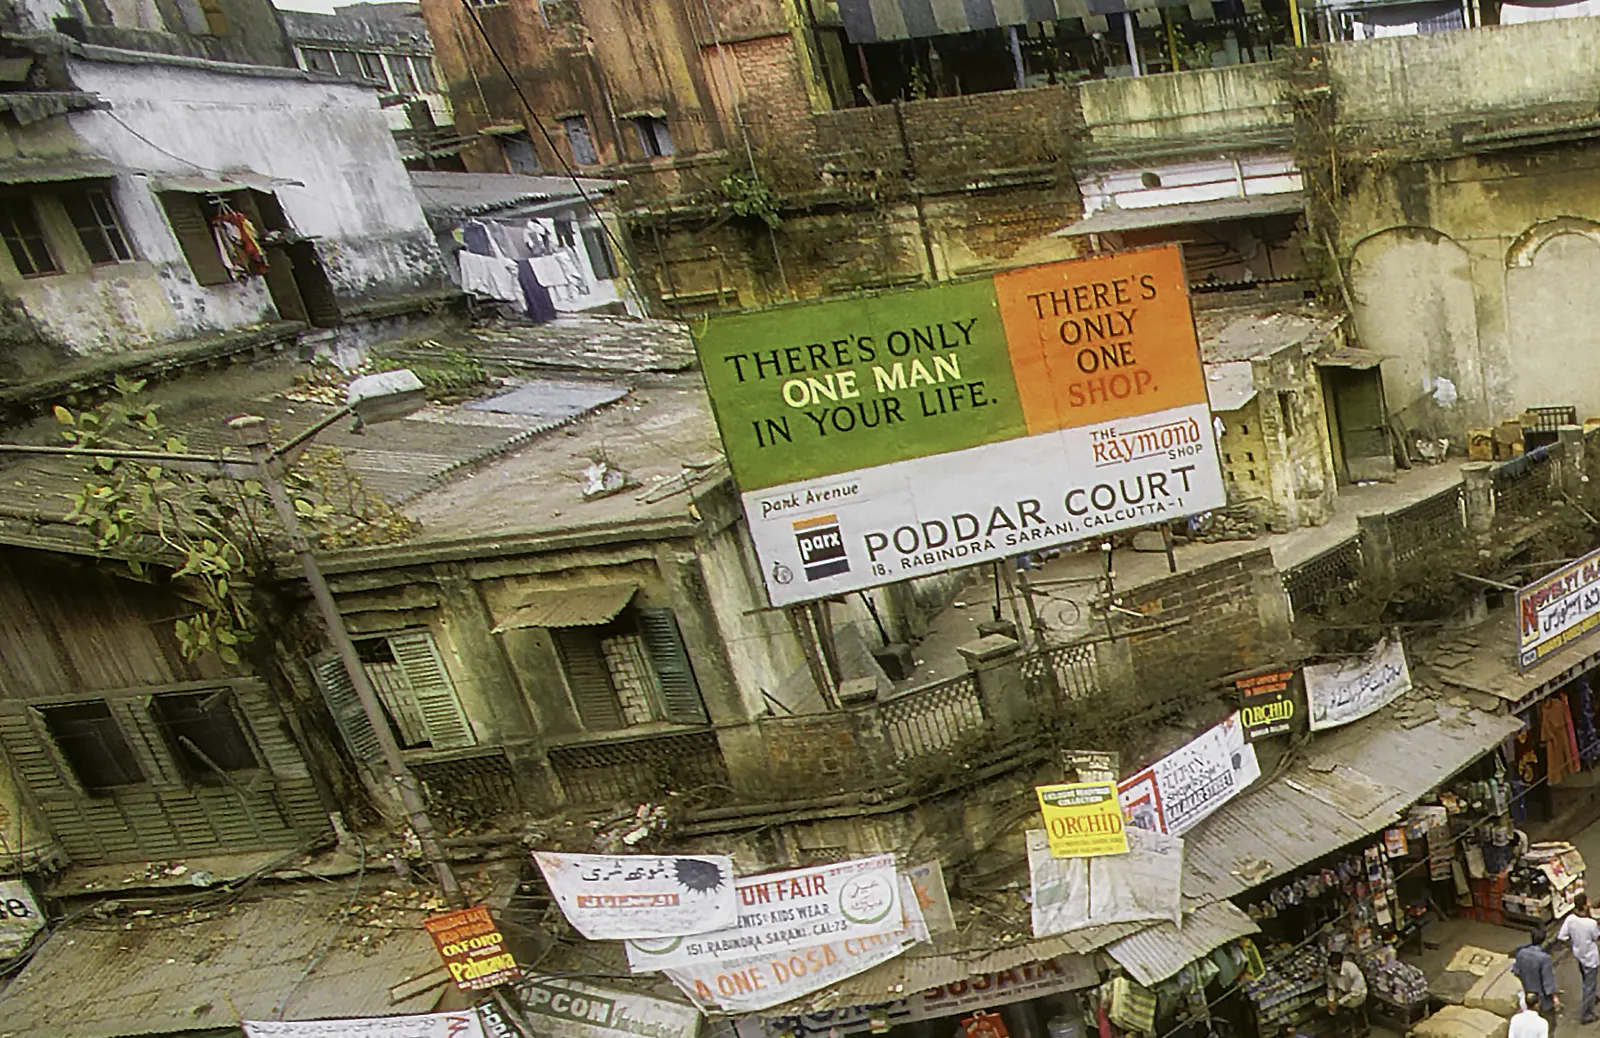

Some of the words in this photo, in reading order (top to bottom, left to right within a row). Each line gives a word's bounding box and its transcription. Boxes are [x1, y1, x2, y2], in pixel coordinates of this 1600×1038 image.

[1027, 274, 1157, 319] THERE'S
[1059, 309, 1138, 346] ONLY
[724, 334, 876, 383] THERE'S
[887, 317, 977, 357] ONLY
[1076, 344, 1136, 374] ONE
[782, 370, 860, 409] ONE
[875, 353, 961, 392] MAN
[1069, 371, 1158, 408] SHOP.
[752, 416, 790, 447] IN
[806, 399, 901, 438] YOUR
[920, 381, 997, 418] LIFE.
[1089, 427, 1117, 442] THE
[1168, 442, 1204, 460] SHOP
[806, 482, 860, 507] Avenue
[863, 498, 1048, 562] PODDAR
[1064, 464, 1196, 516] COURT
[800, 531, 842, 565] parx
[900, 537, 996, 570] RABINDRA
[736, 882, 771, 906] UN
[776, 874, 828, 900] FAIR
[737, 912, 763, 928] ENTS
[771, 908, 795, 923] KIDS
[798, 903, 830, 920] WEAR
[694, 977, 714, 1001] A
[717, 965, 767, 996] ONE
[772, 945, 838, 984] DOSA
